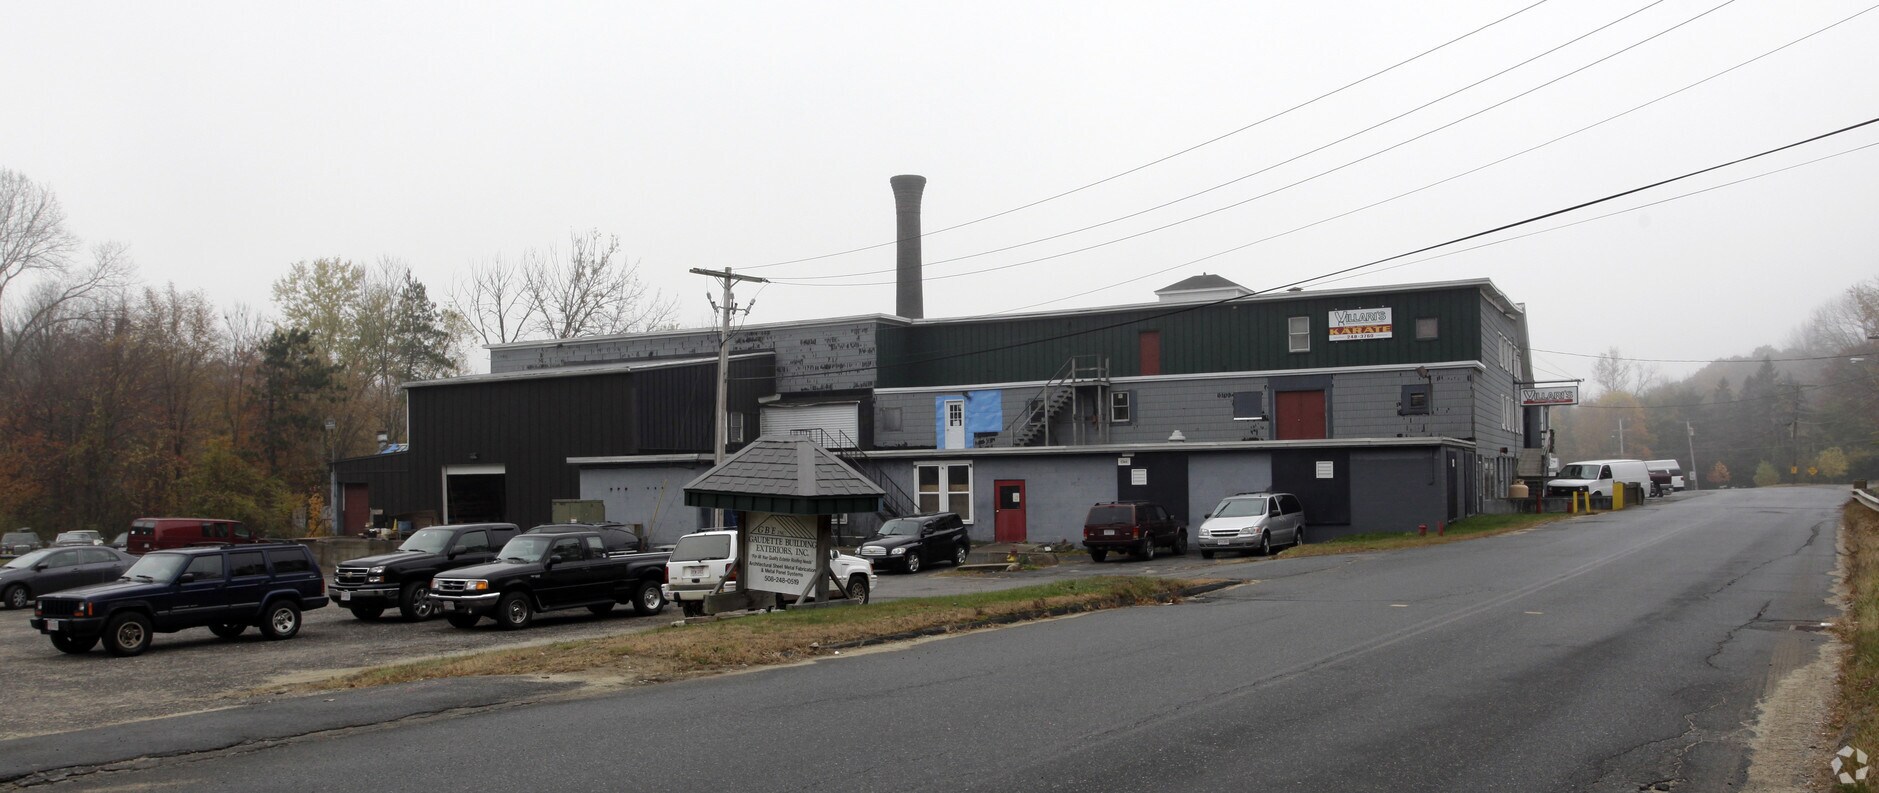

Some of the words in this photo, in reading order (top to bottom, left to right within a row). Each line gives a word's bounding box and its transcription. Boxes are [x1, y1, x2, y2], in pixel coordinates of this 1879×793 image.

[1335, 311, 1386, 325] VILLARI'S
[1330, 325, 1391, 335] KARATE
[1523, 390, 1573, 400] VILLARI'S
[749, 536, 783, 546] GAUDETTE
[785, 539, 817, 549] BUILDING
[756, 545, 793, 556] EXTERIORS,
[796, 548, 809, 557] INC.
